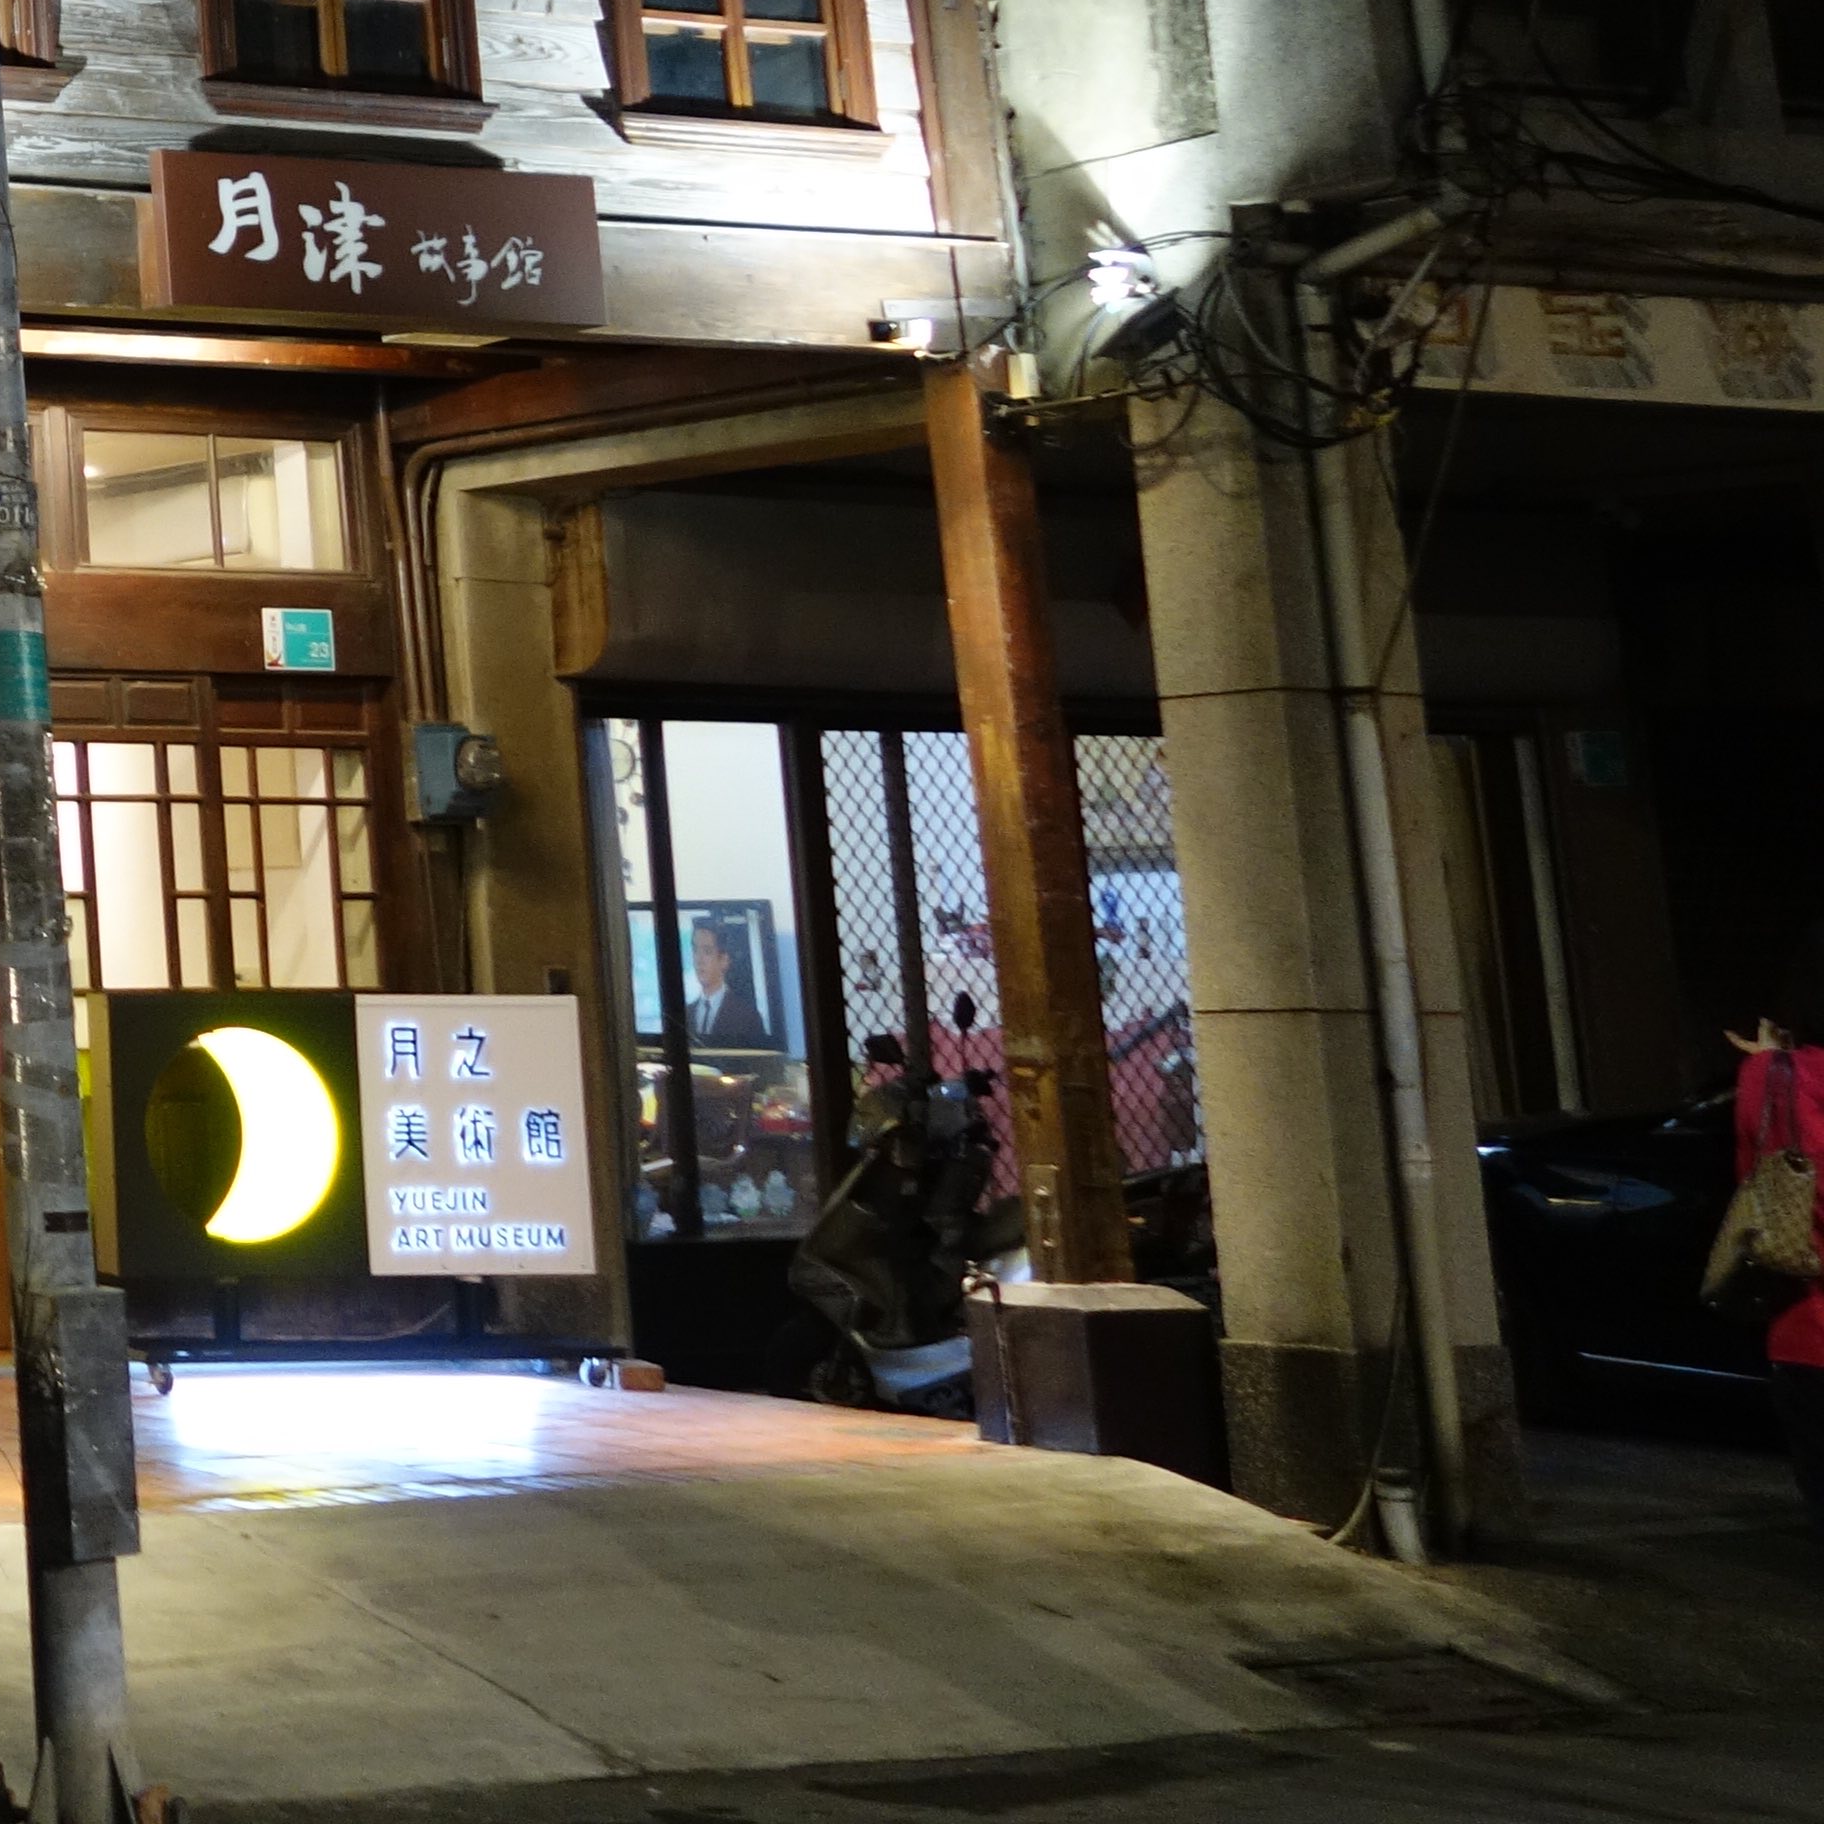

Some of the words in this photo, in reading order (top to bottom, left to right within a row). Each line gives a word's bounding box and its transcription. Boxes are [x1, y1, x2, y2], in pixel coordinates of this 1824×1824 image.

[392, 1108, 563, 1162] 美術館
[393, 1188, 488, 1213] YUEJIN
[396, 1226, 444, 1250] ART
[455, 1227, 568, 1250] MUSEUM
